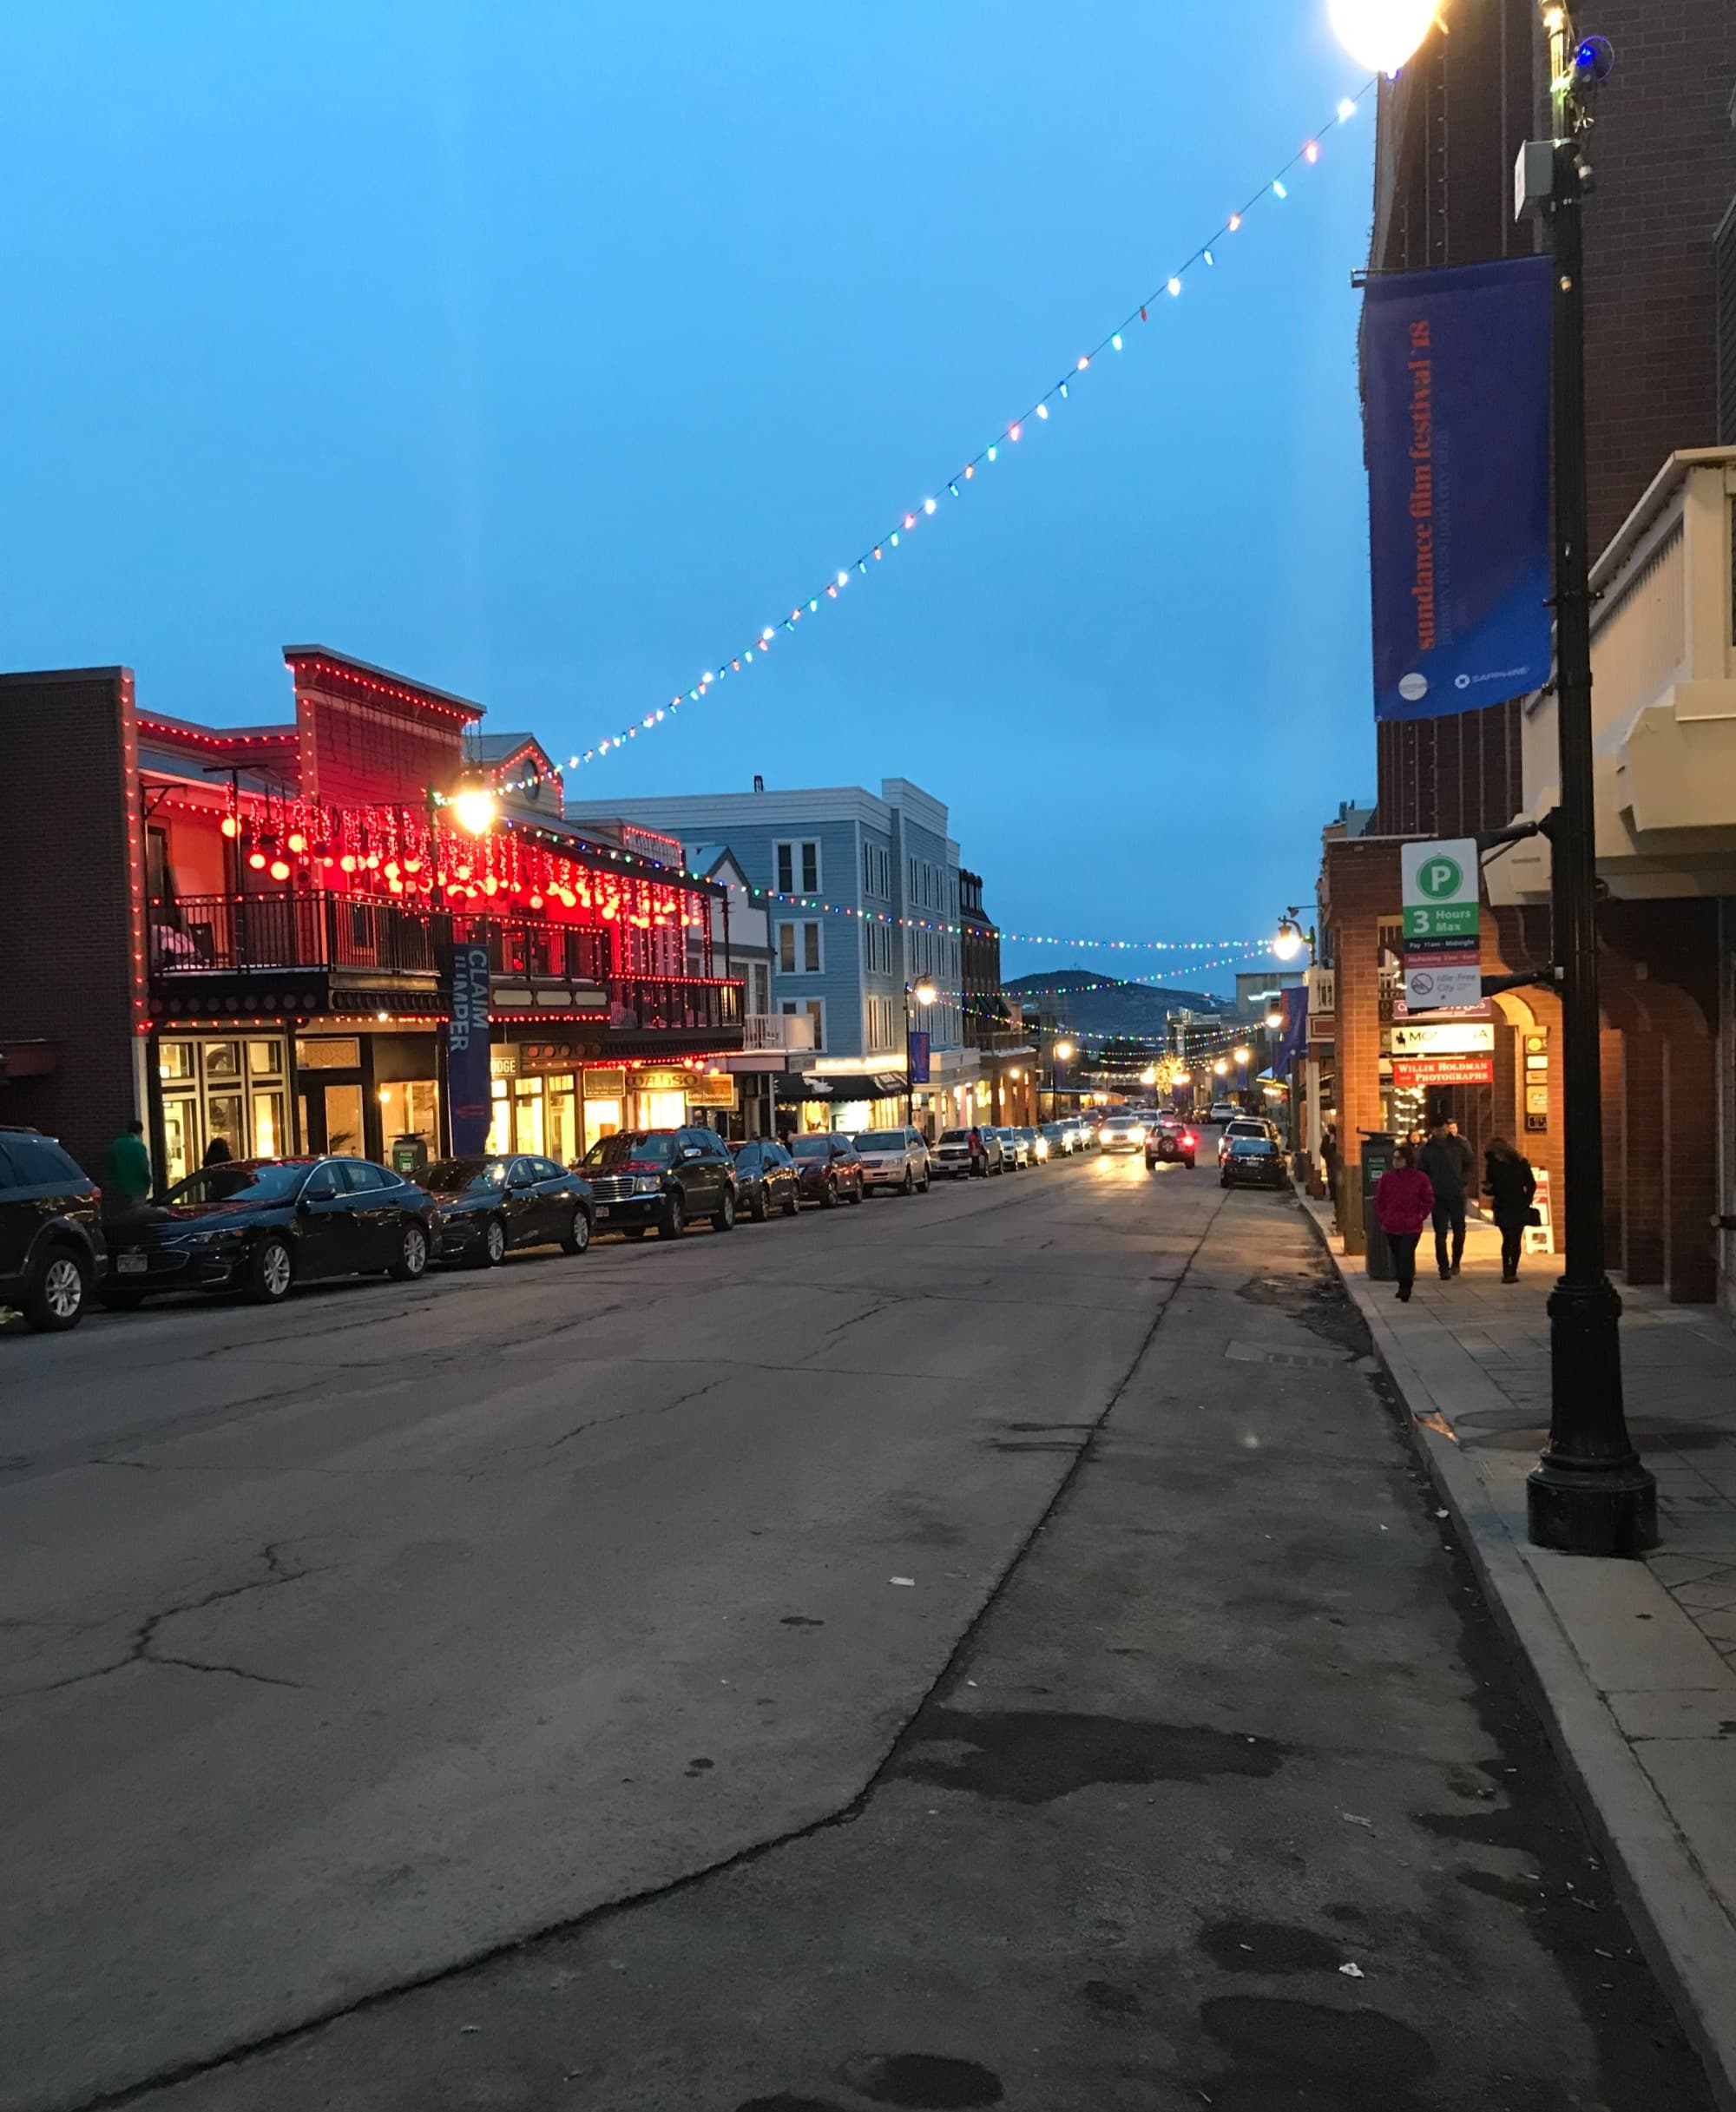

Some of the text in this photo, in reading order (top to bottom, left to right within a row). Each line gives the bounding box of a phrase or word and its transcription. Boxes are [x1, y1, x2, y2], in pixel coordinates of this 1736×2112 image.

[1408, 360, 1431, 459] festival
[1409, 464, 1431, 518] film
[1411, 523, 1435, 650] sundance
[1431, 865, 1451, 892] P
[1413, 910, 1471, 934] 3 Hours
[1436, 922, 1461, 931] Max
[468, 949, 490, 1030] CLAIM
[1397, 1062, 1488, 1073] WILLIE HOLDMAN
[1415, 1072, 1488, 1082] PHOTOGRAPHS
